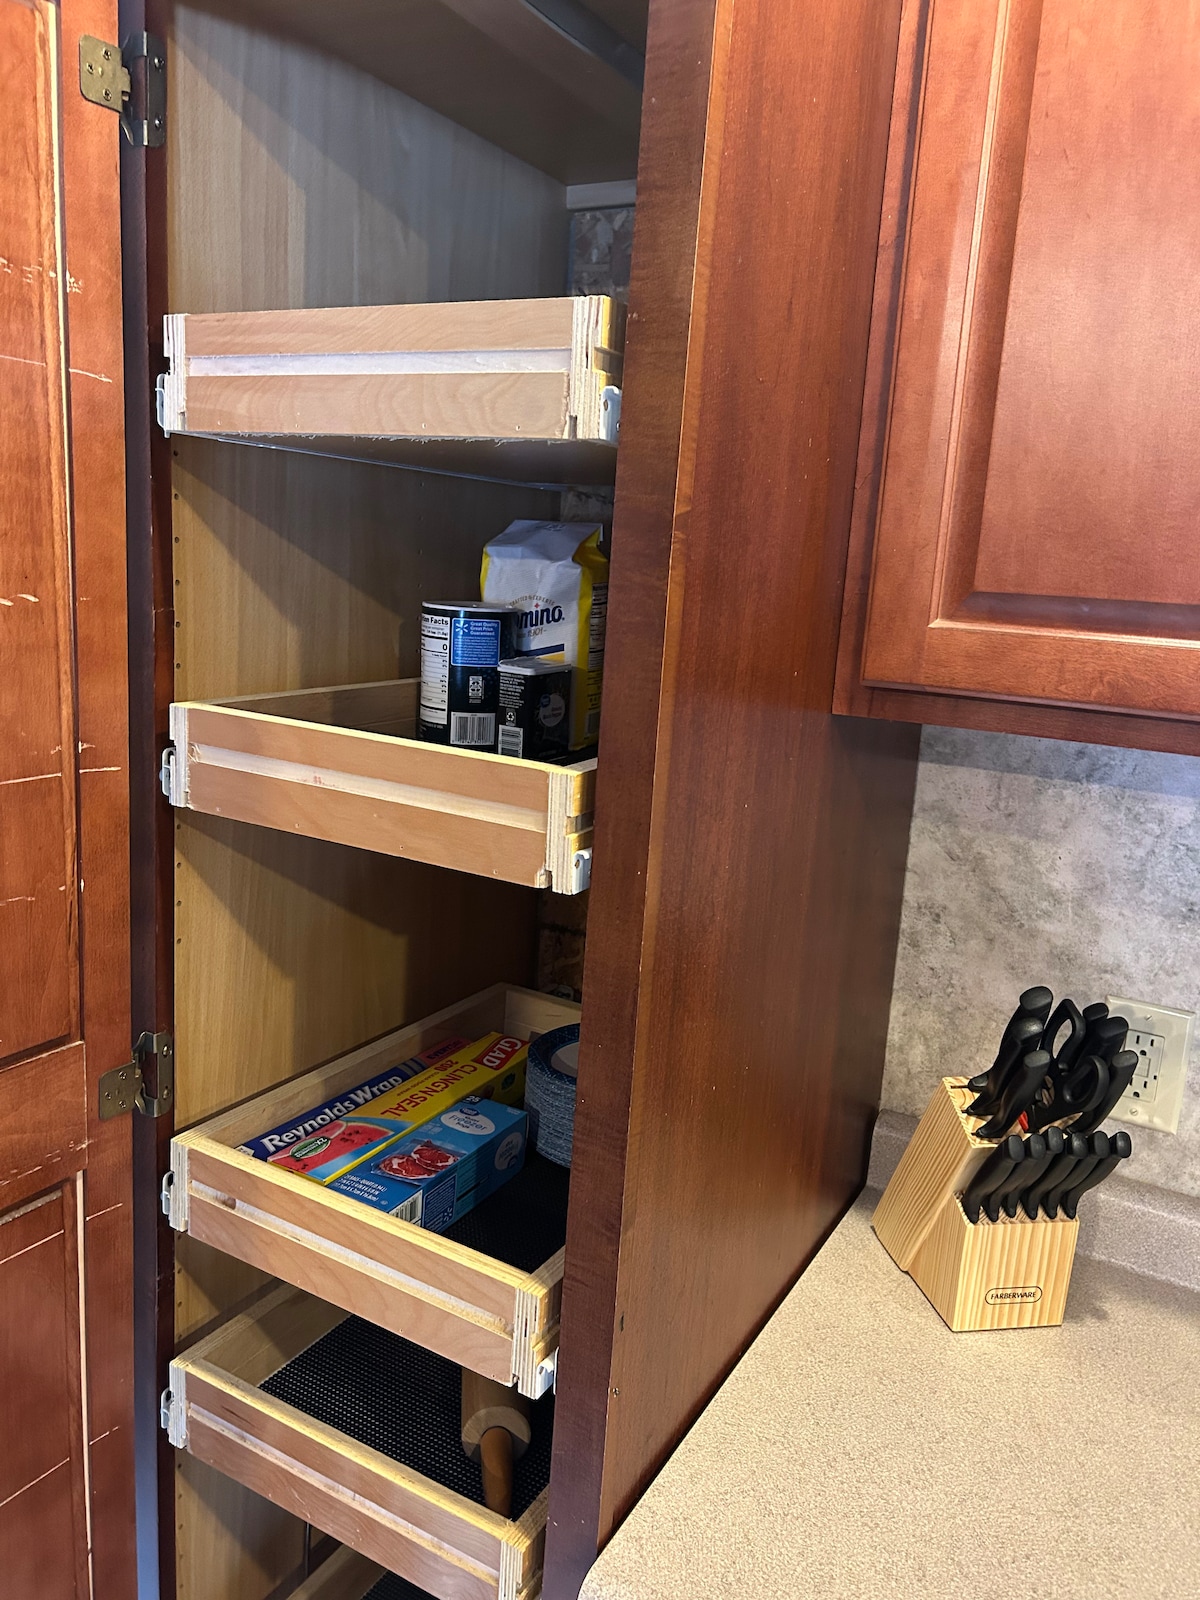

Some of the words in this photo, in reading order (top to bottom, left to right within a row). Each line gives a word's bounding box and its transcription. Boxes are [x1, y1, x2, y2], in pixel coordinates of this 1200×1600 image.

[430, 616, 448, 625] Facts
[516, 605, 563, 629] mino
[482, 1037, 522, 1068] GLAD
[260, 1100, 356, 1153] Reynolds
[349, 1075, 402, 1105] Wrap
[448, 1114, 487, 1130] Freezer
[990, 1291, 1036, 1300] FARBERWARE
